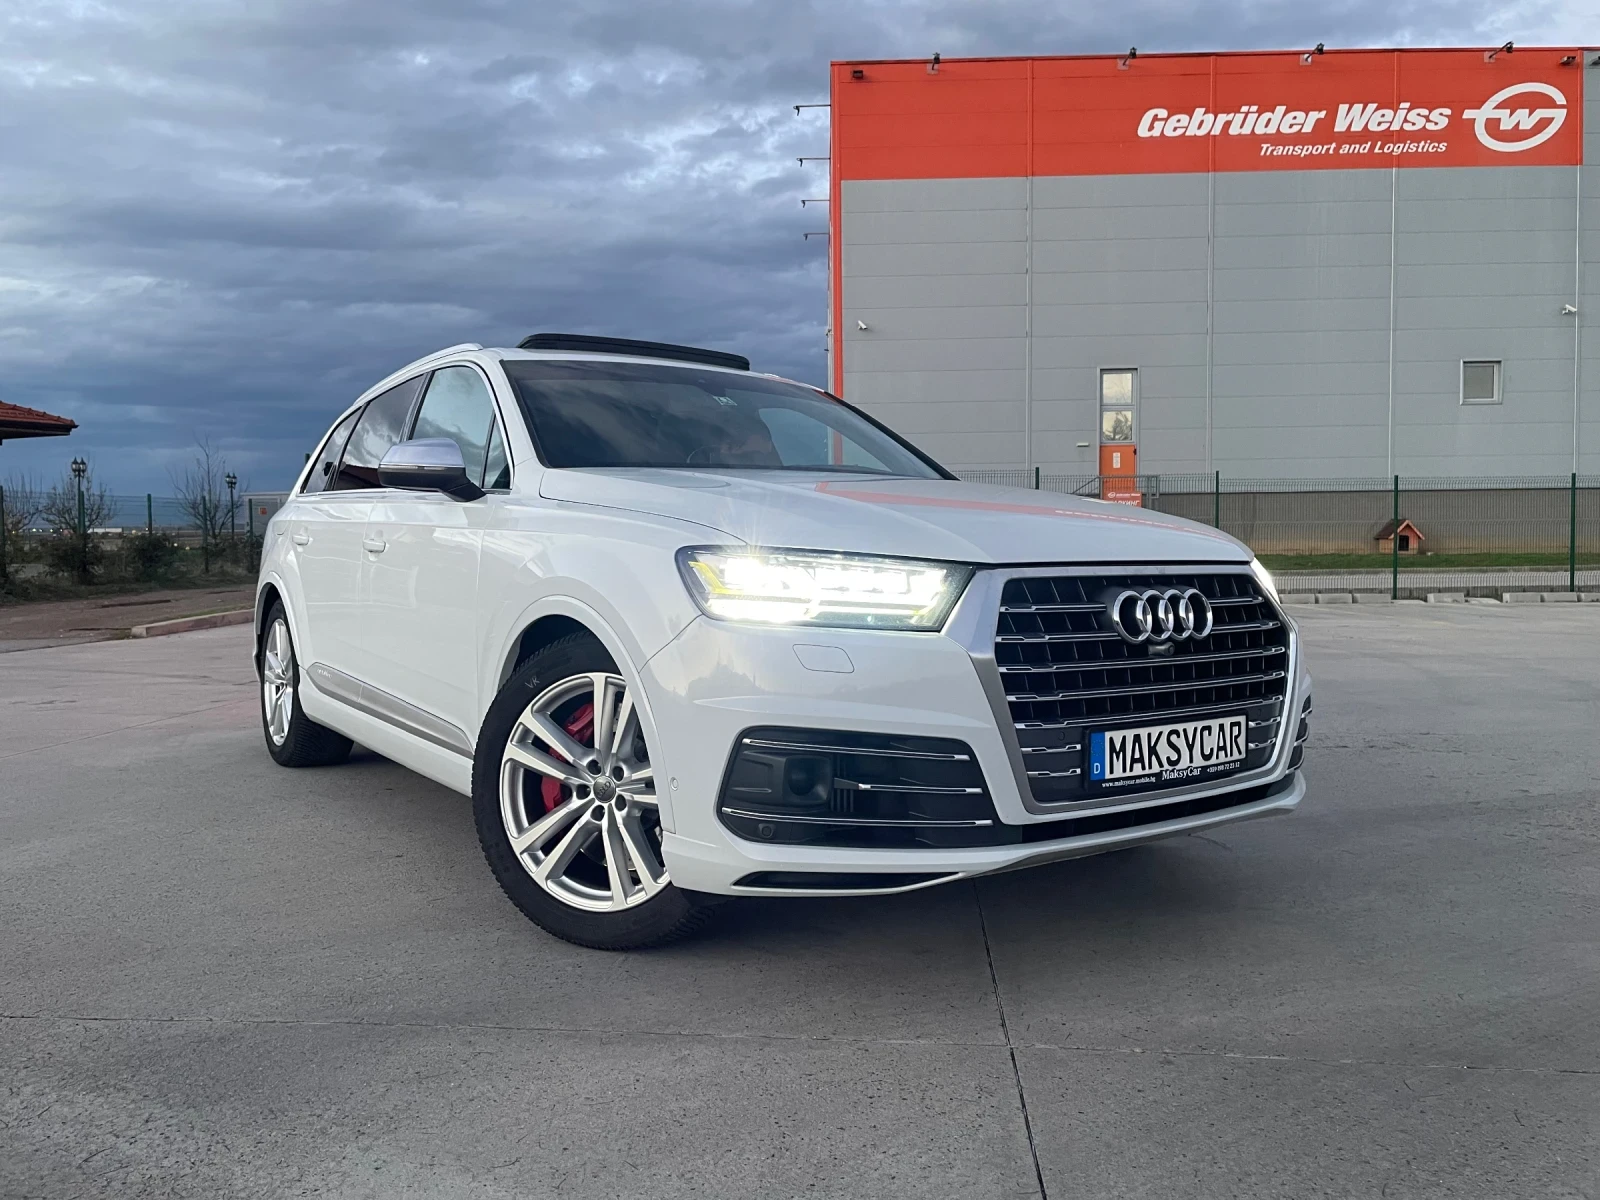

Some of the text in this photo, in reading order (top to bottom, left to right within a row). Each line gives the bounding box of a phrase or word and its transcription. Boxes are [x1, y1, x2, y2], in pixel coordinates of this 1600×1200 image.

[1137, 102, 1452, 138] Gebrüder Weiss
[1260, 140, 1447, 158] Transport and Logistics
[1109, 721, 1243, 775] MAKSYCAR
[1093, 762, 1101, 775] D
[1161, 766, 1202, 781] MaksyCar
